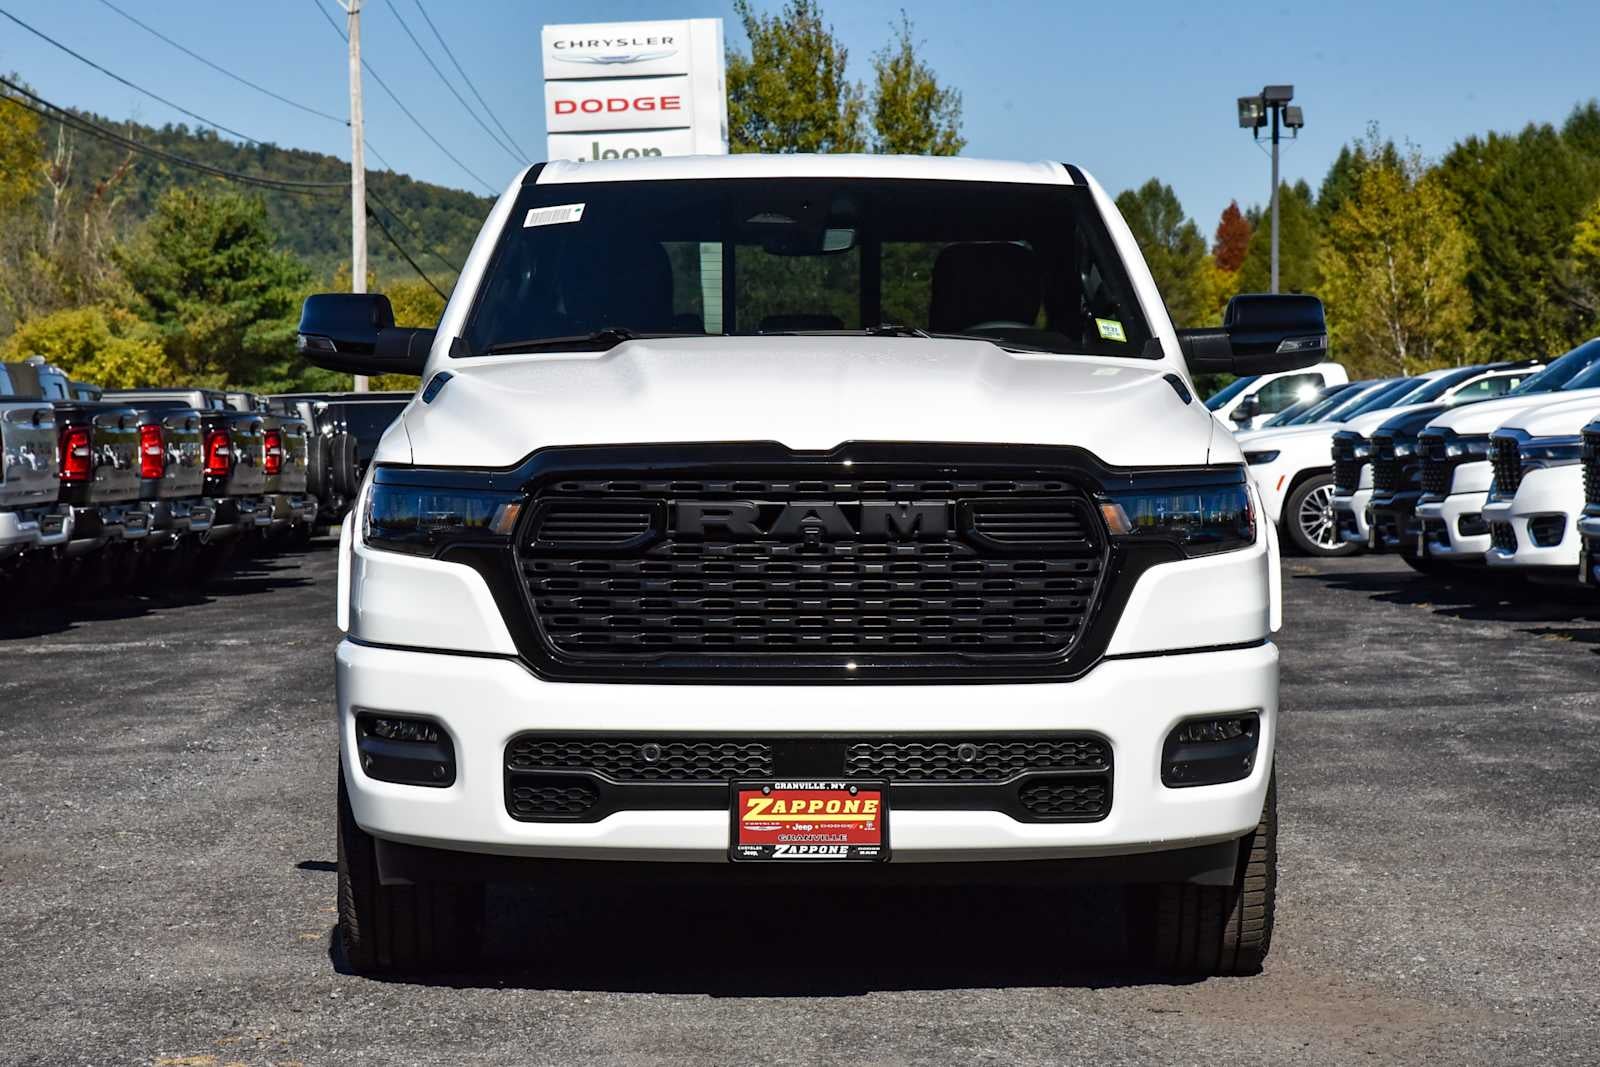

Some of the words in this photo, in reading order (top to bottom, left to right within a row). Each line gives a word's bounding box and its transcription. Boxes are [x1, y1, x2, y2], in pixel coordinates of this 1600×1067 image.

[553, 37, 674, 50] CHRYSLER
[554, 96, 681, 115] DODGE
[677, 500, 948, 537] RAM
[742, 798, 879, 821] ZAPPONE
[792, 823, 813, 831] Jeep
[778, 834, 848, 842] GRANVILLE
[772, 844, 849, 858] ZAPPONE
